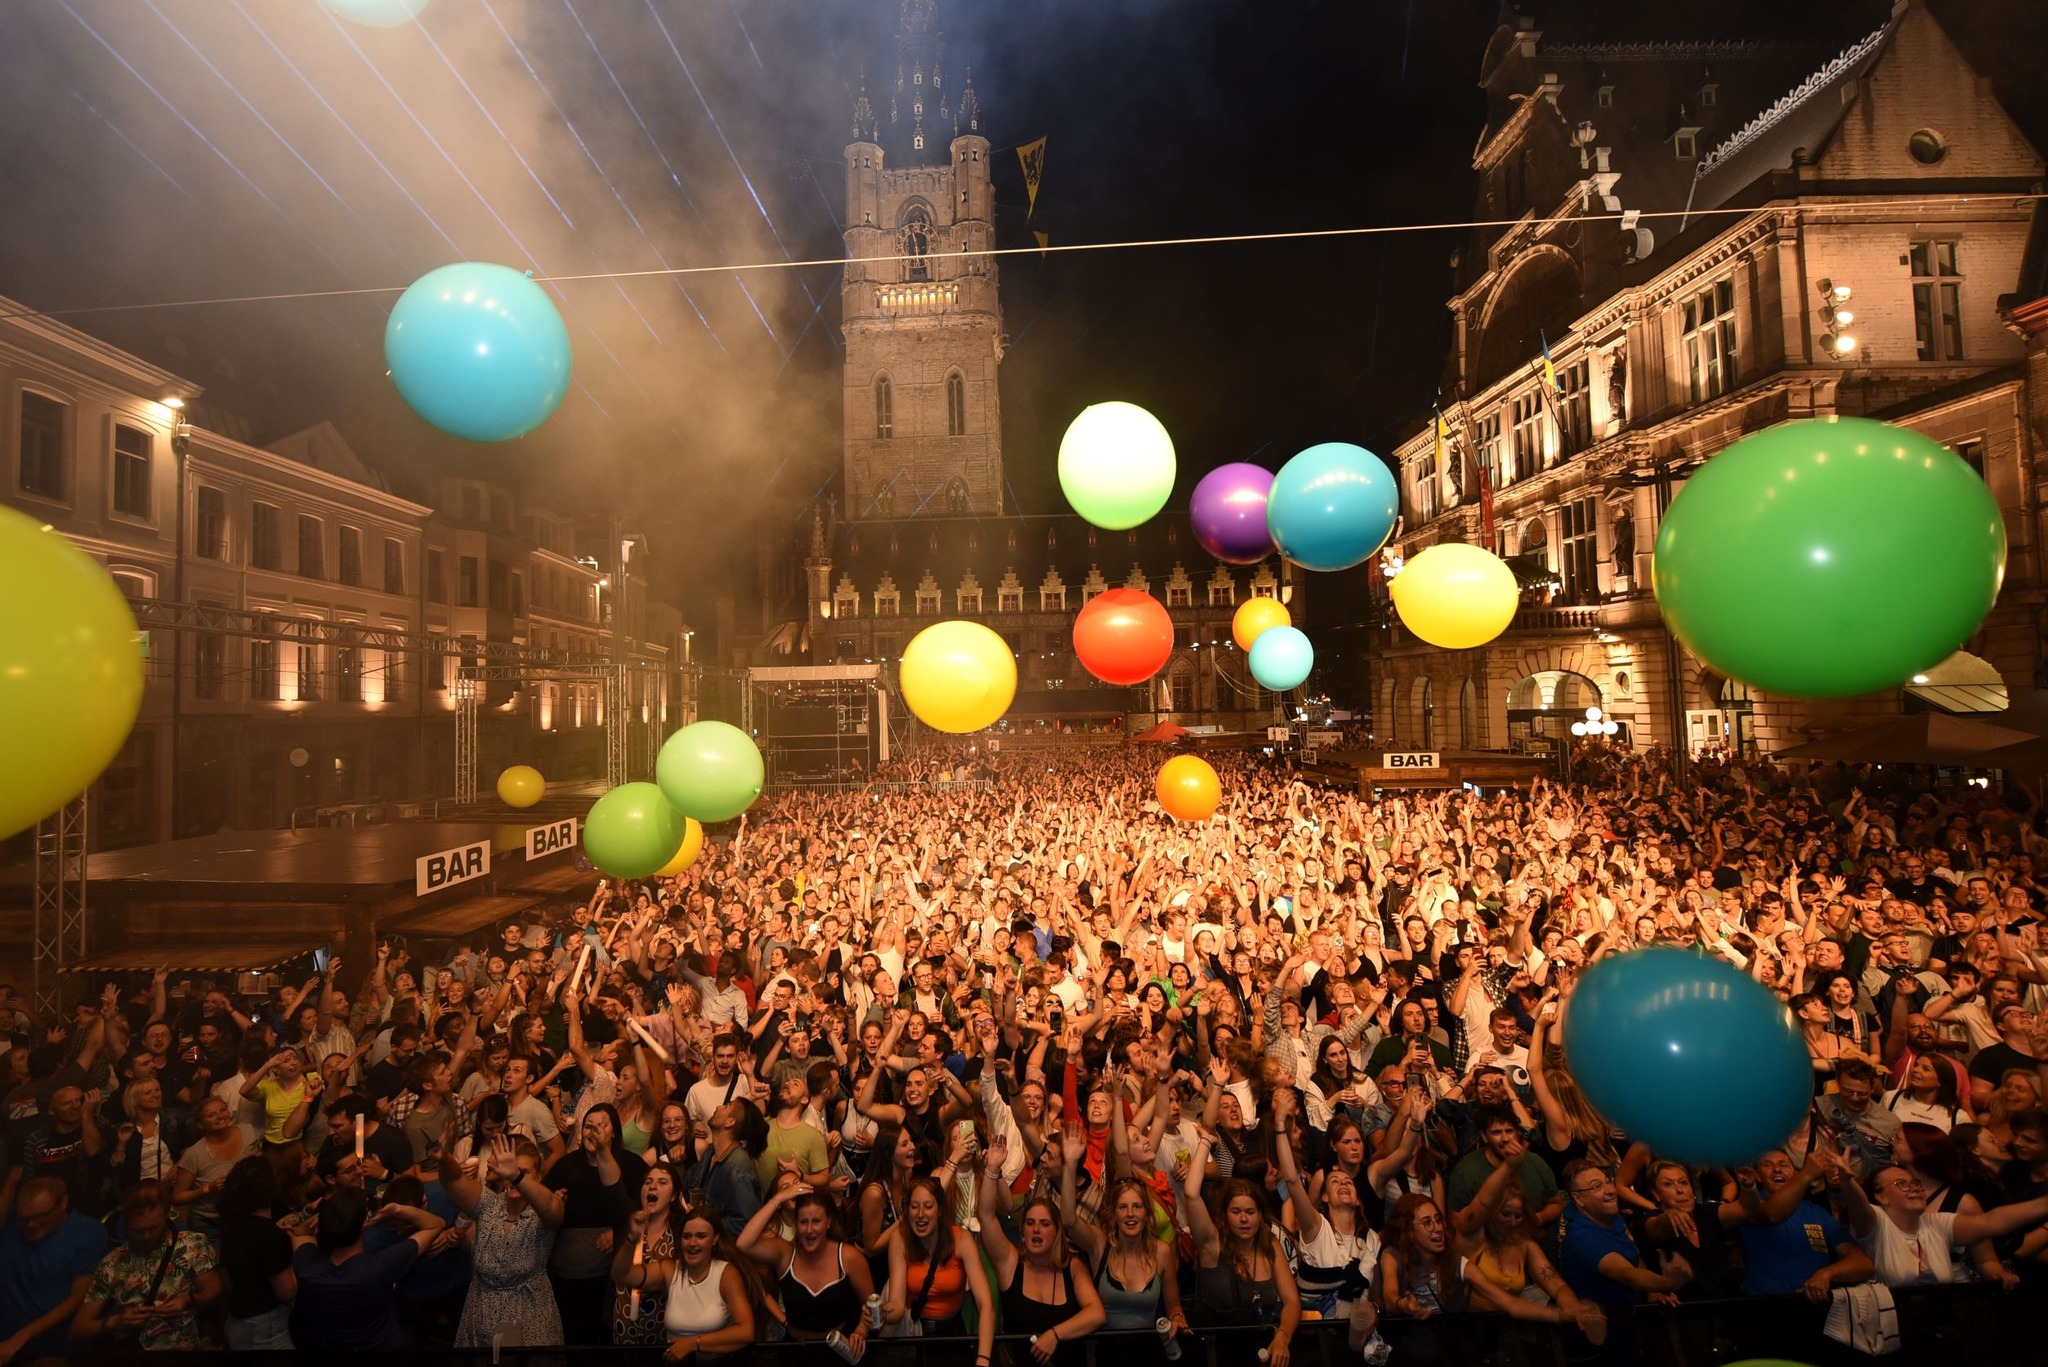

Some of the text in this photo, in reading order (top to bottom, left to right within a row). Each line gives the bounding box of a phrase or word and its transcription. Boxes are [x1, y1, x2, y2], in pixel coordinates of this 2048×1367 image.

[1302, 751, 1315, 763] BAR
[1390, 755, 1433, 767] BAR
[533, 822, 572, 855] BAR
[427, 846, 483, 889] BAR
